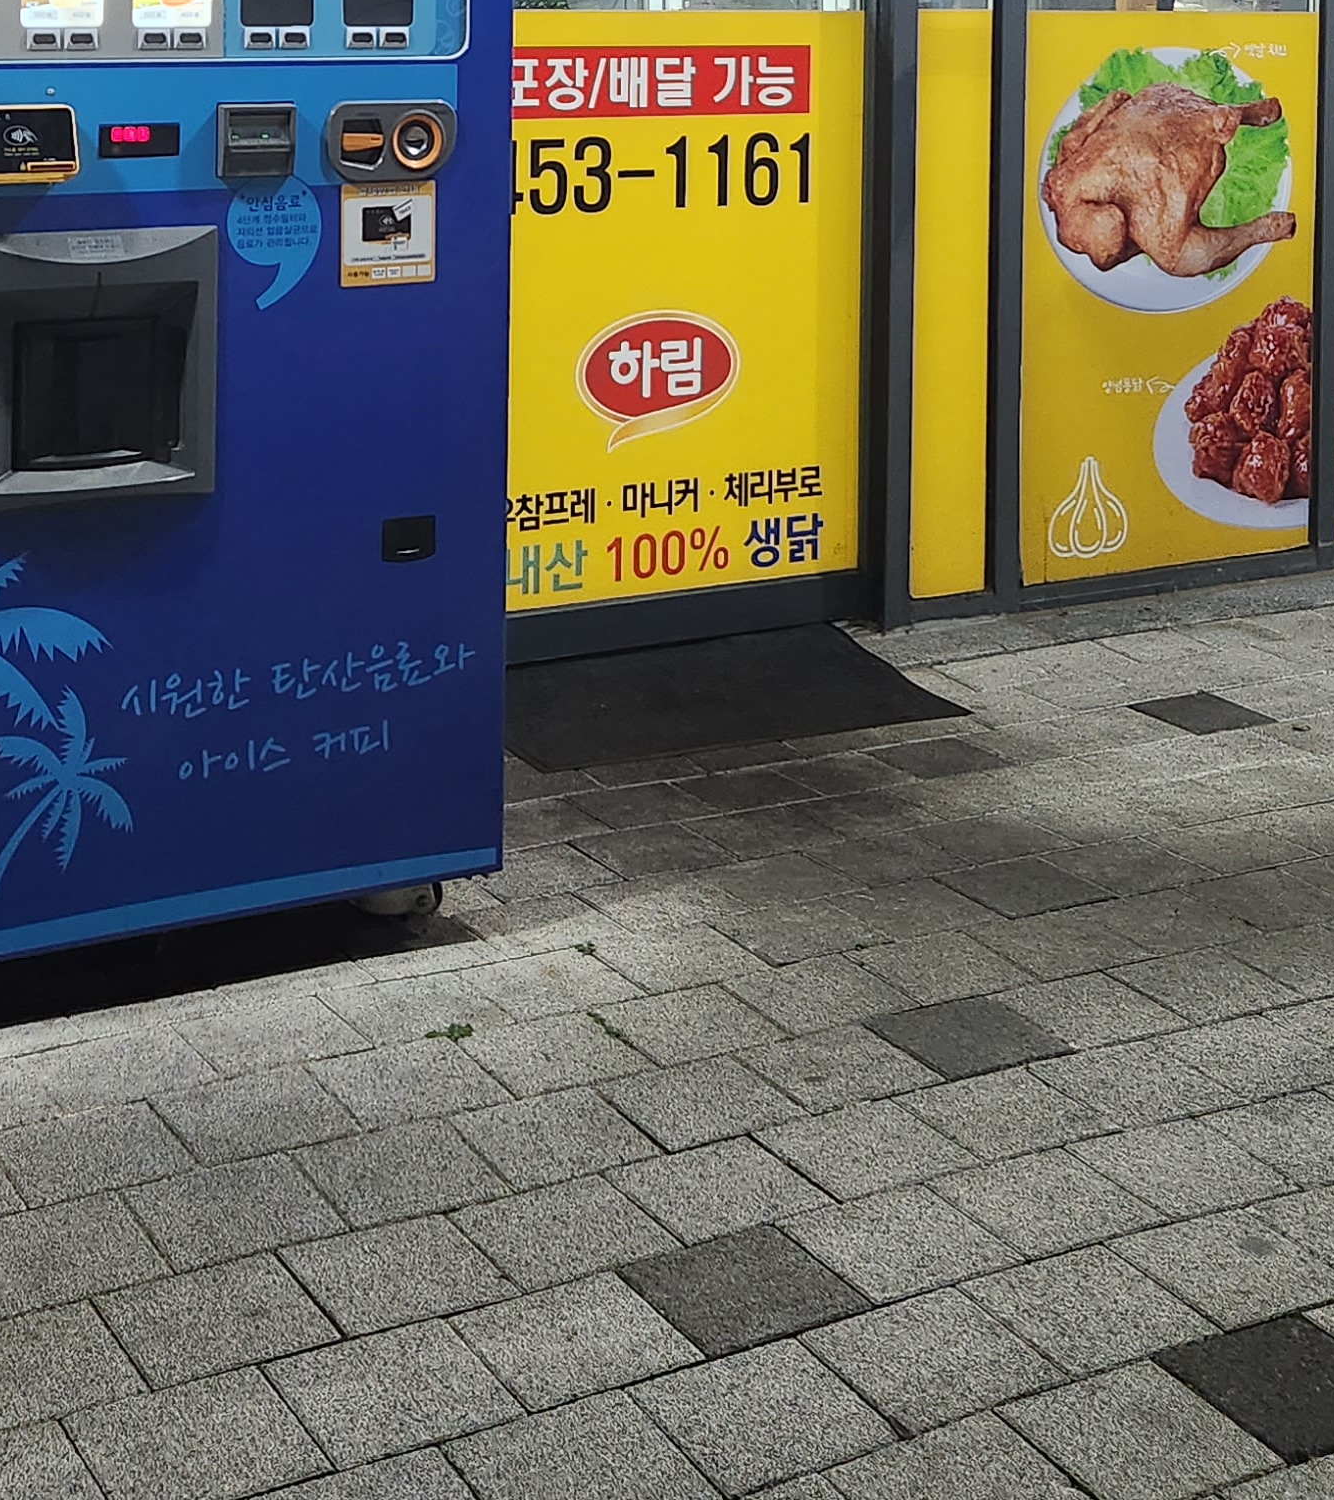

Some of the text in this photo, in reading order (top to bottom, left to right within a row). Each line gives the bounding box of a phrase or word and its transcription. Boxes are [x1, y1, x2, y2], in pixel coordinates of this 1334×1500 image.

[713, 55, 796, 107] 가능
[608, 337, 704, 399] 하림
[621, 477, 700, 518] 마니커
[724, 466, 824, 508] 체리부로
[606, 527, 730, 583] 100%
[743, 515, 824, 568] 생닭
[121, 665, 251, 720] 시원한
[178, 720, 392, 781] 아이스 커피
